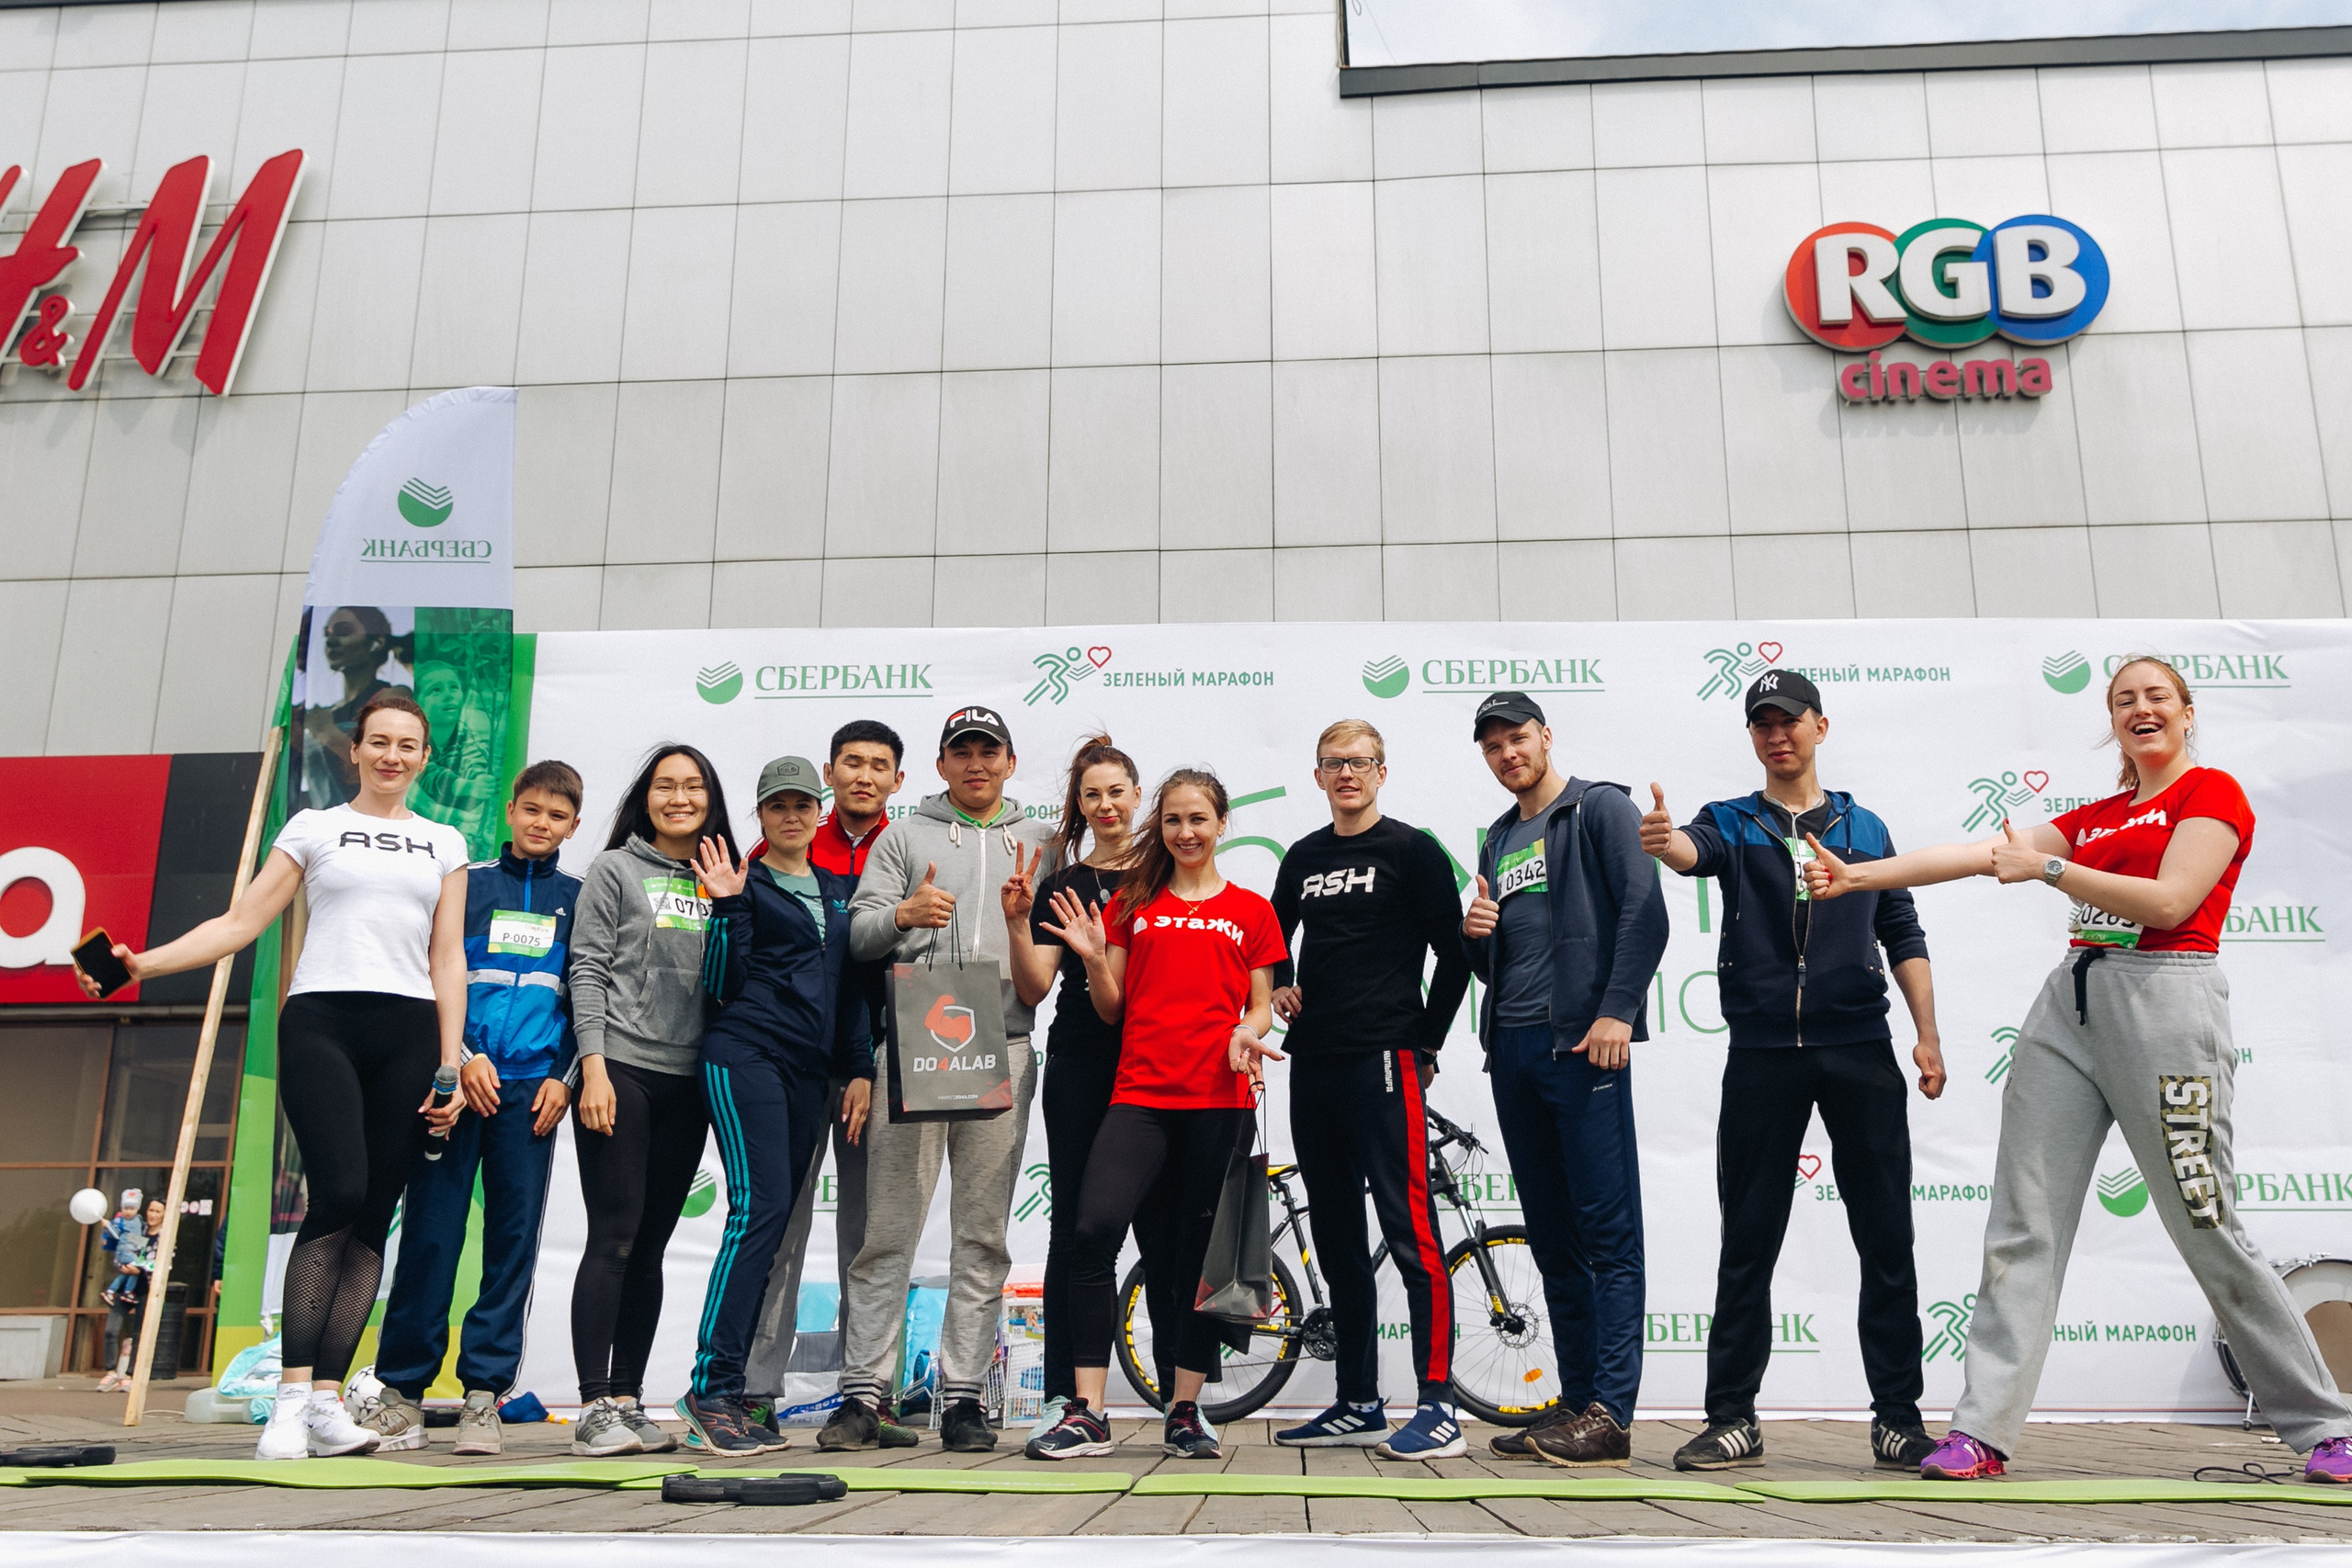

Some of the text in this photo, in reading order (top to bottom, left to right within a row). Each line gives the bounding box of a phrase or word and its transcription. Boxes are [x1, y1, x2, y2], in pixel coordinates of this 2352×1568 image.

[1814, 224, 2087, 325] RGB
[1838, 350, 2053, 401] cinema
[755, 663, 933, 691] СБЕРБАНК
[1102, 668, 1274, 687] ЗЕЛЕНЫЙ МАРАФОН
[1422, 659, 1604, 685] СБЕРБАНК
[1758, 673, 1780, 694] NY
[1868, 667, 1951, 682] МАРАФОН
[949, 708, 1000, 728] FILA
[339, 830, 435, 860] ASH
[1300, 866, 1376, 900] ASH
[1506, 859, 1546, 891] 0342
[1153, 916, 1245, 947] этажи
[2224, 906, 2325, 933] БАНК
[502, 932, 541, 947] P-0075
[912, 1054, 997, 1073] DO4ALAB
[2165, 1081, 2220, 1221] STREET
[2235, 1173, 2352, 1201] РБАНК
[2105, 1324, 2197, 1342] МАРАФОН
